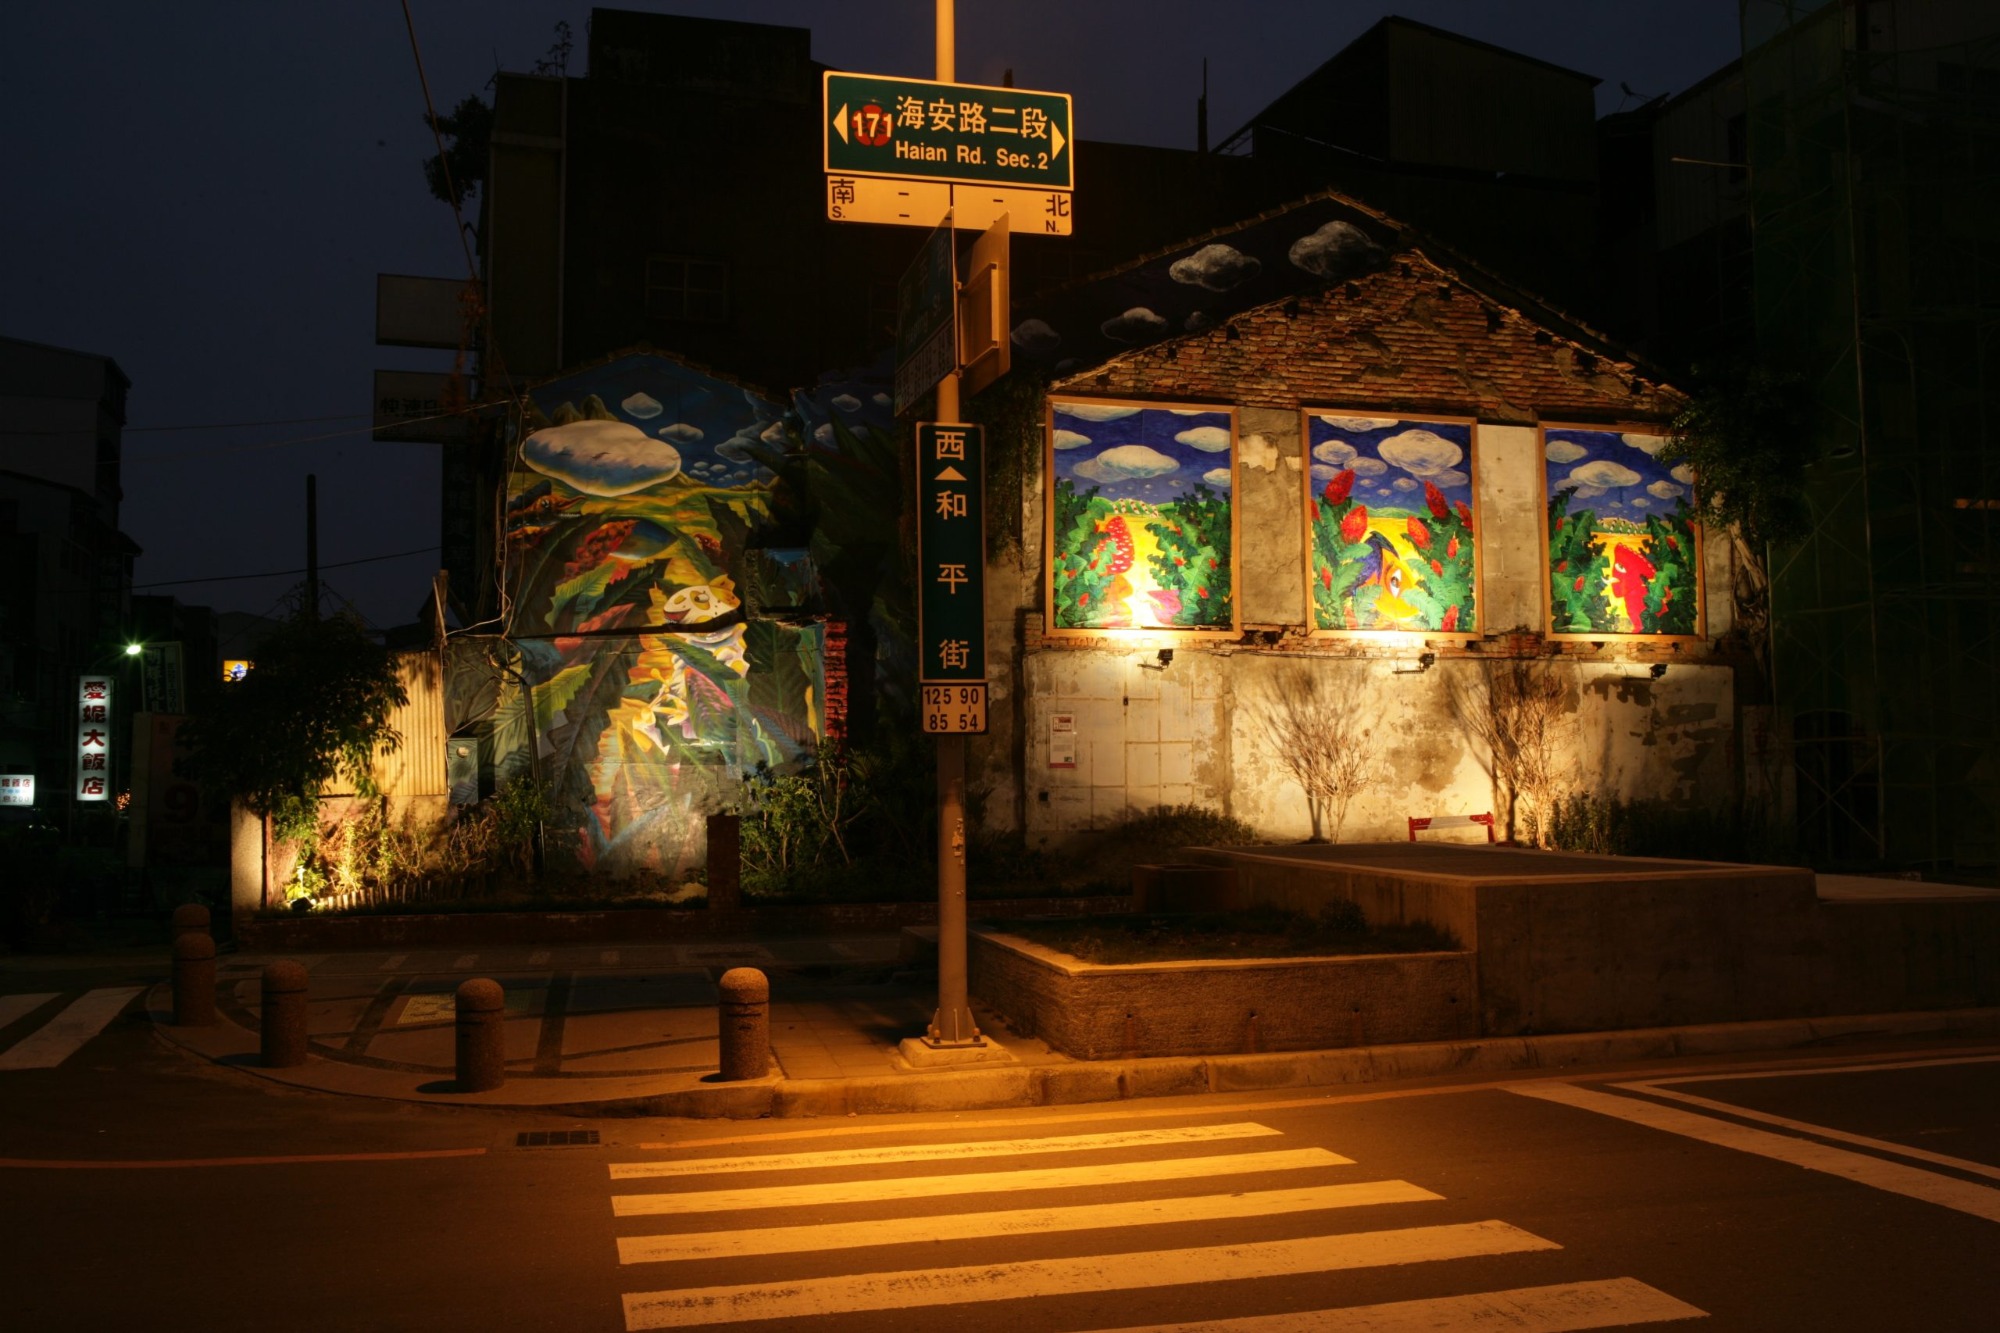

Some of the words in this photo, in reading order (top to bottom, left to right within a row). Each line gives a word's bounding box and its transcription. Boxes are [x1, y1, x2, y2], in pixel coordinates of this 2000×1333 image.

[853, 112, 892, 138] 171
[896, 95, 1048, 140] 海安路二段
[896, 141, 947, 162] Haian
[957, 145, 987, 165] Rd.
[830, 178, 855, 205] 南
[832, 206, 846, 218] S.
[1045, 194, 1069, 217] 北
[1045, 220, 1060, 233] N.
[935, 431, 965, 460] 西
[935, 490, 970, 670] 和平街
[924, 688, 952, 705] 125
[960, 688, 979, 705] 90
[930, 714, 948, 731] 85
[959, 713, 978, 730] 54
[81, 681, 107, 795] 愛妮大飯店
